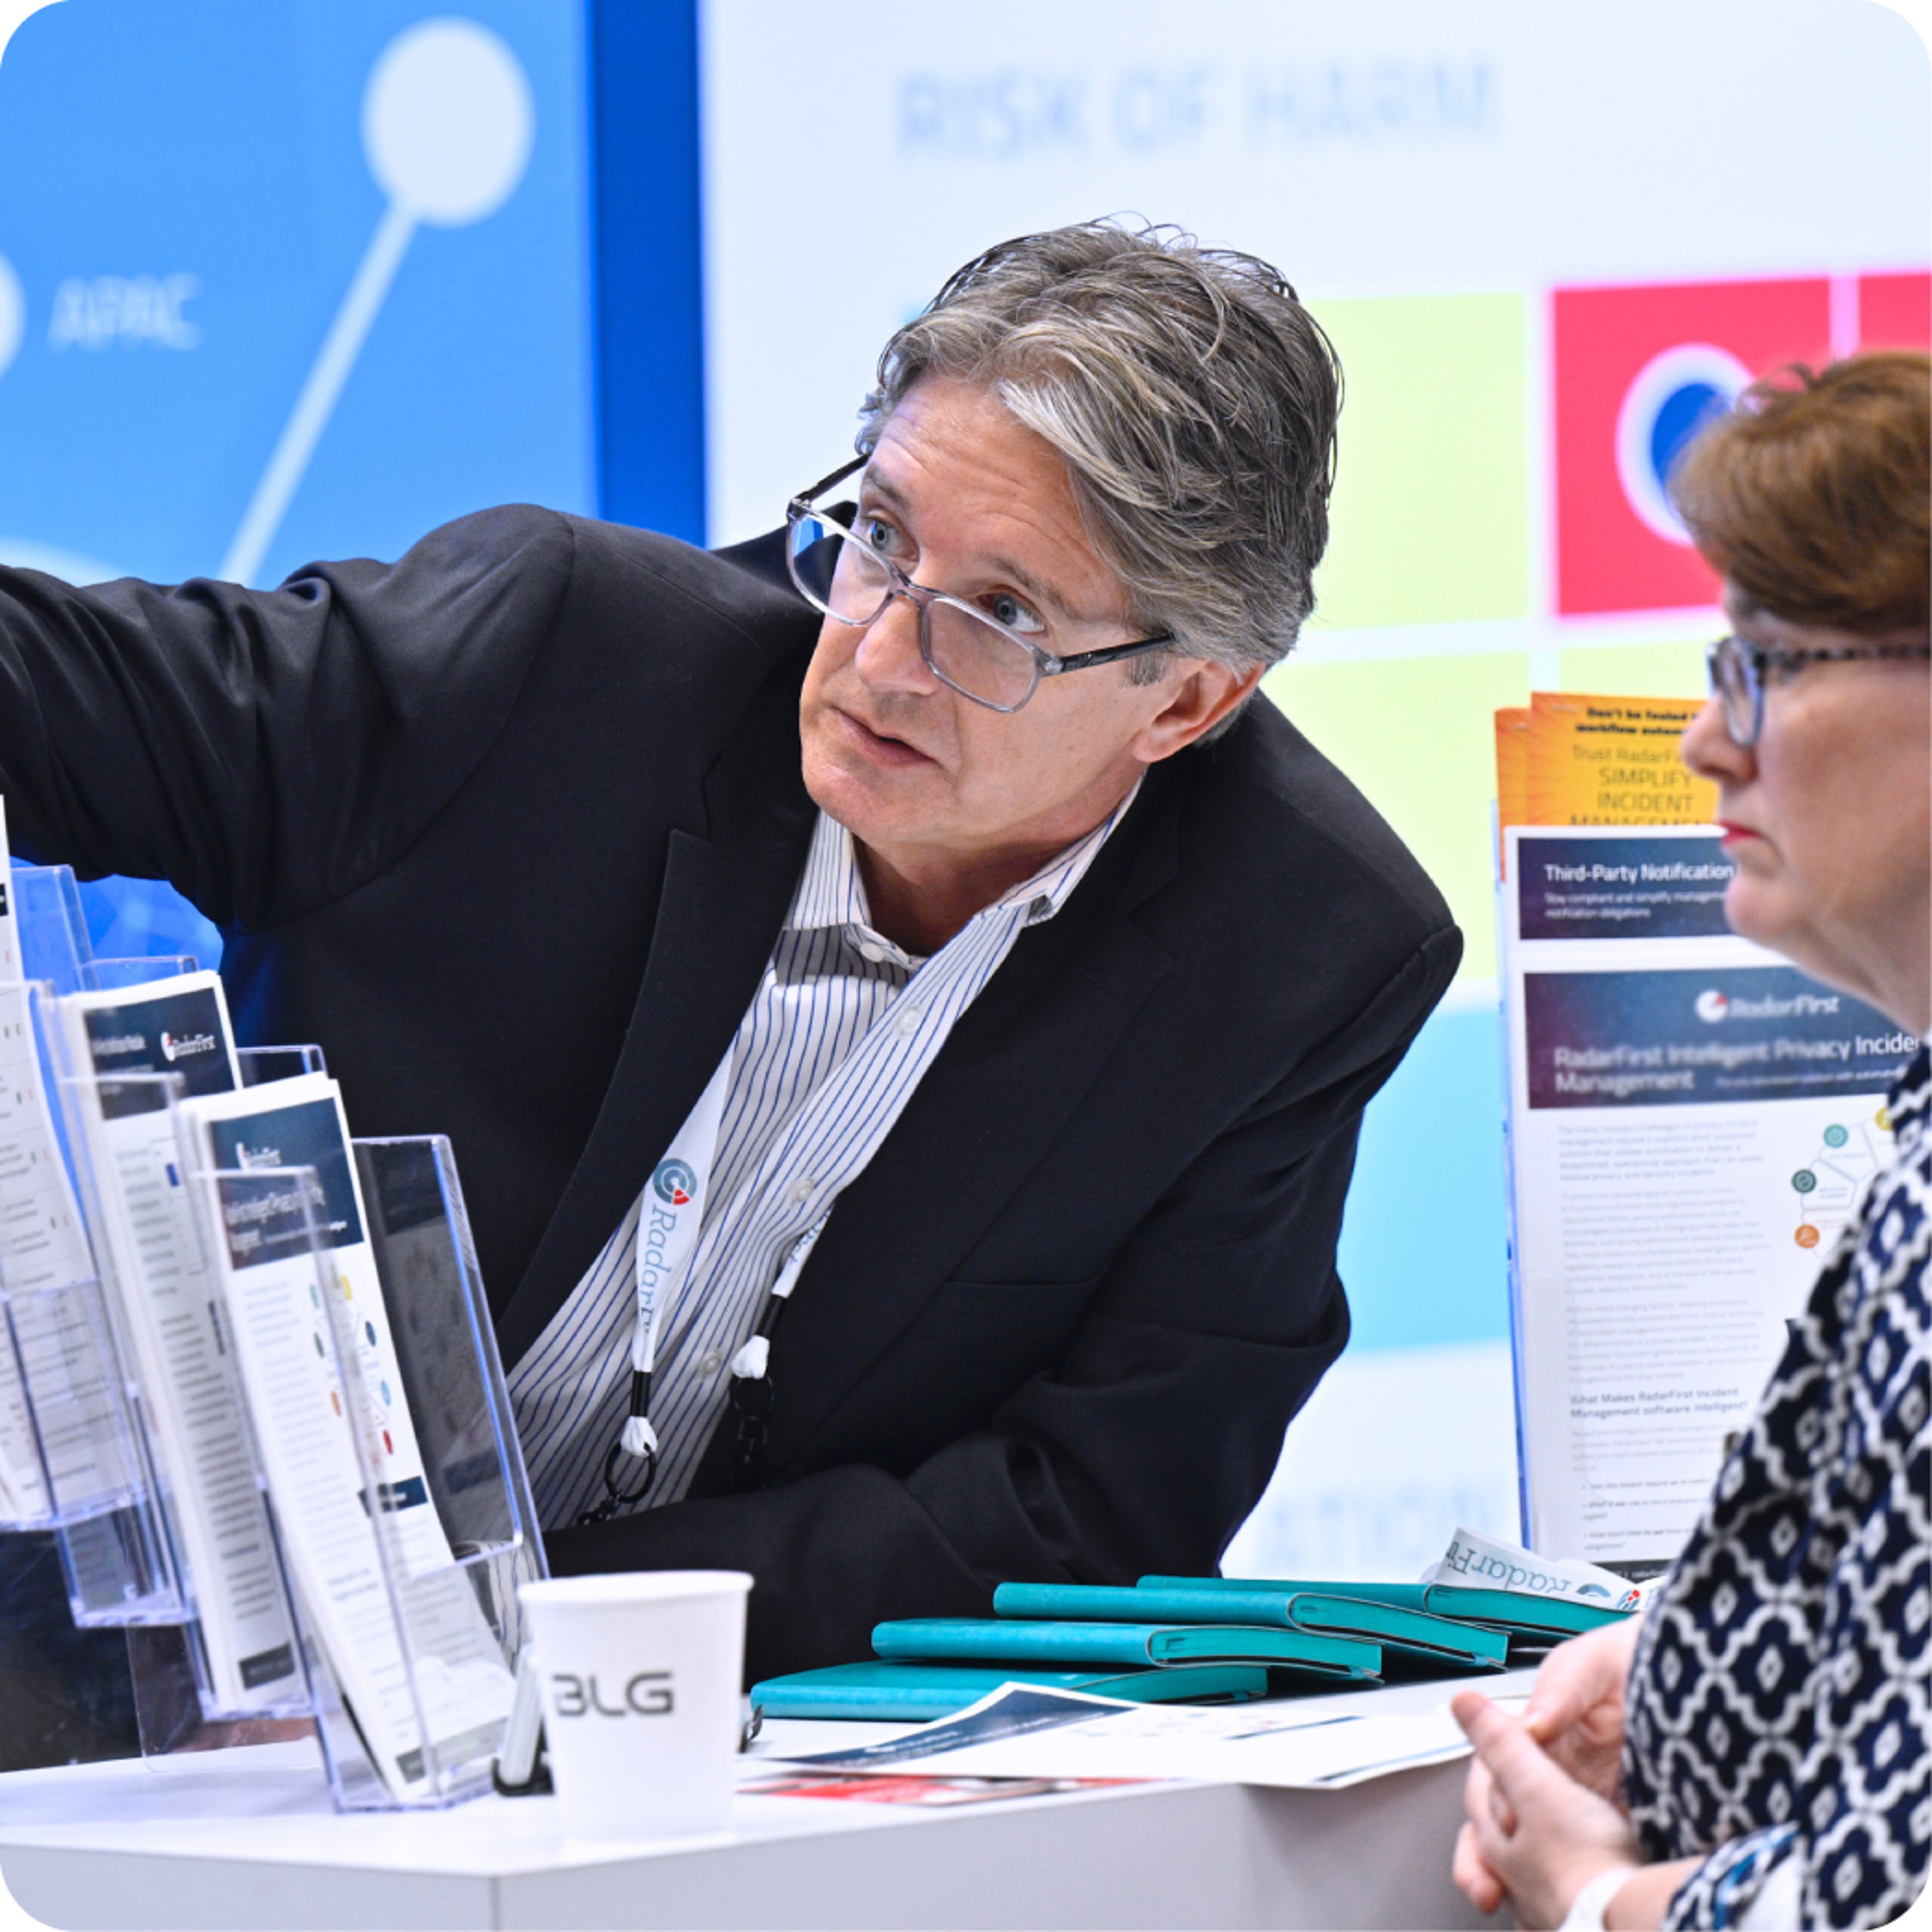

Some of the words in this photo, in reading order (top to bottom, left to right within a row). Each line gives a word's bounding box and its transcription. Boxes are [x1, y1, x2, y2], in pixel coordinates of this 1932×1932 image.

[897, 69, 1091, 163] RISK
[1111, 56, 1220, 157] OF
[1243, 53, 1501, 153] HARM
[1627, 709, 1641, 719] be
[1576, 722, 1637, 735] workflow
[1572, 745, 1612, 761] Trust
[1616, 746, 1681, 762] RadarFi
[1599, 769, 1694, 788] SIMPLIFY
[1597, 794, 1693, 812] INCIDENT
[1544, 863, 1637, 884] Third-Party
[1728, 995, 1840, 1019] RadarFirst
[1554, 1045, 1664, 1070] RadarFirst
[1669, 1040, 1768, 1068] Intelligent
[1774, 1038, 1851, 1062] Privacy
[1555, 1071, 1695, 1096] Management
[1601, 1394, 1635, 1403] Makes
[1639, 1391, 1694, 1401] RadarFirst
[1570, 1407, 1640, 1419] Management
[1644, 1404, 1690, 1414] software
